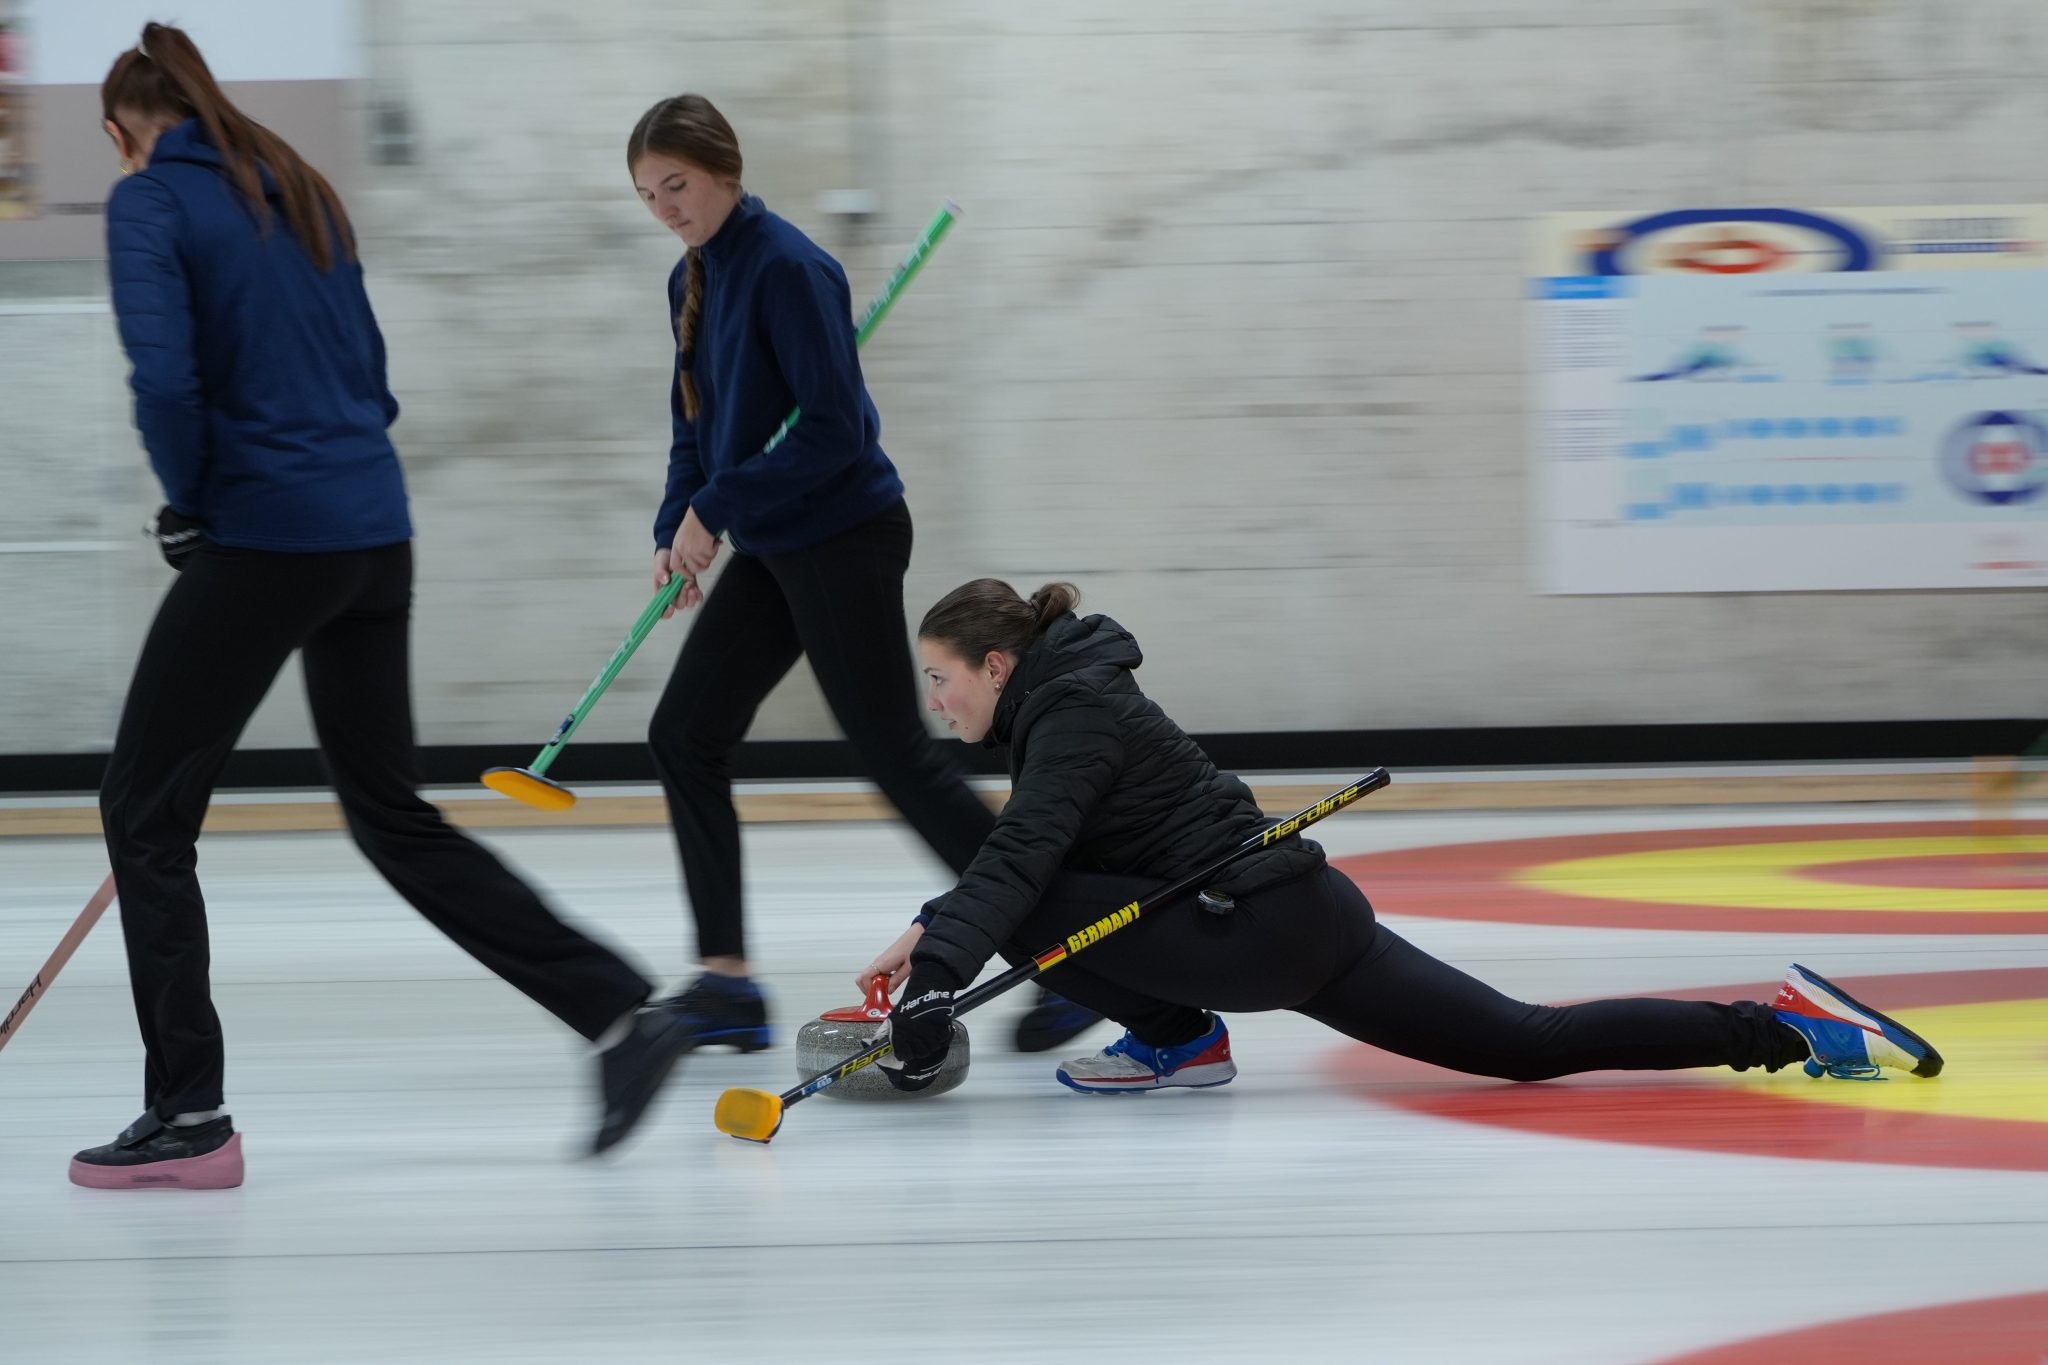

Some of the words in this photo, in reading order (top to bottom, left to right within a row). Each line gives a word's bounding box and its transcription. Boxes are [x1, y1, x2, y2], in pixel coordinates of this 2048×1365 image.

[1263, 785, 1359, 846] Hardline
[1066, 900, 1140, 954] GERMANY
[900, 989, 950, 1013] Hardline
